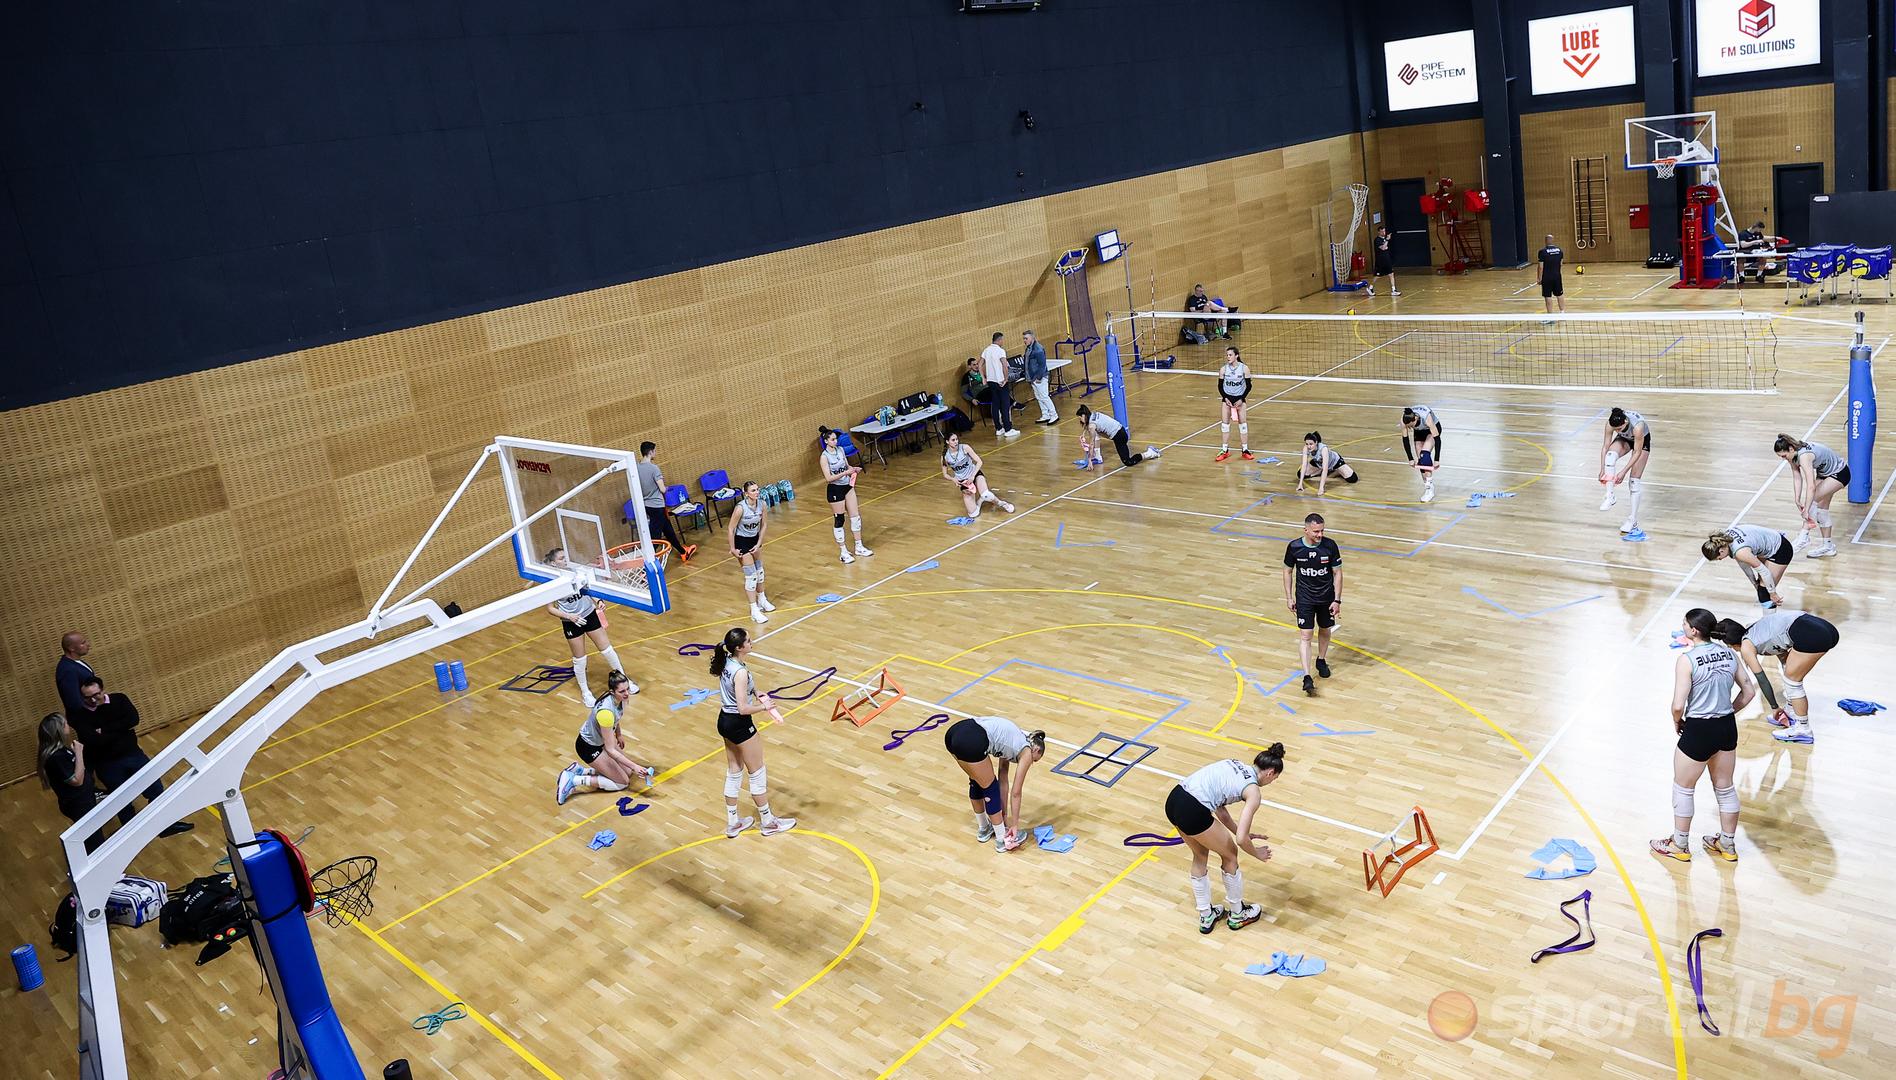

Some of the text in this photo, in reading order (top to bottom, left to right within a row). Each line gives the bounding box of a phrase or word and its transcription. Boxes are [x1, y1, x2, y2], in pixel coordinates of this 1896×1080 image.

[1562, 29, 1600, 52] LUBE
[1721, 38, 1795, 58] FM SOLUTIONS
[1421, 61, 1445, 71] PIPE
[1421, 67, 1466, 80] SYSTEM
[1852, 409, 1861, 440] Senoh
[1300, 566, 1329, 577] efbet
